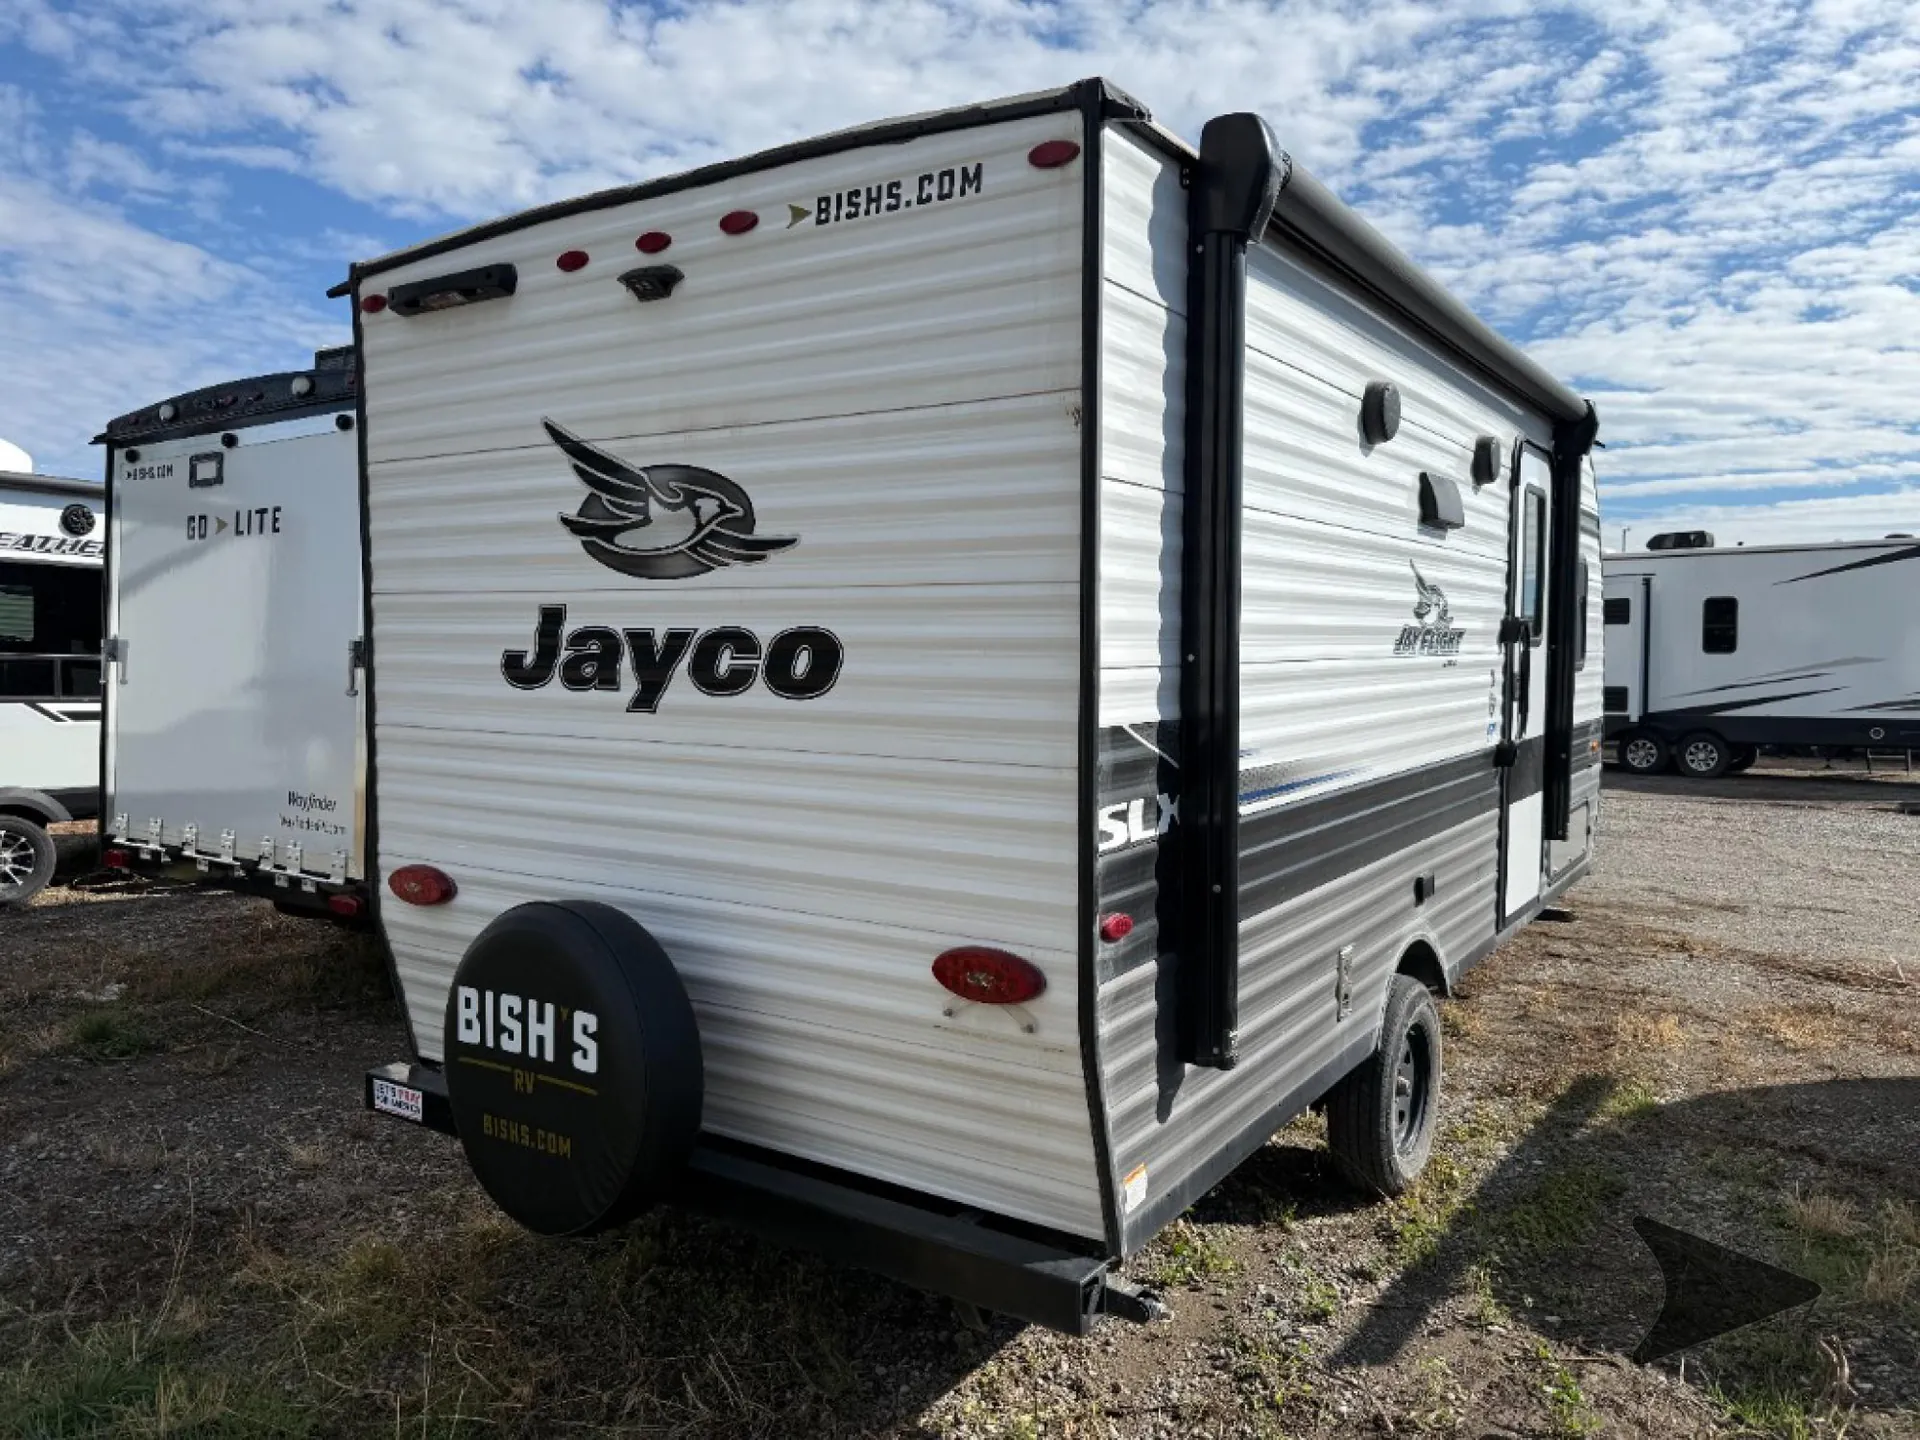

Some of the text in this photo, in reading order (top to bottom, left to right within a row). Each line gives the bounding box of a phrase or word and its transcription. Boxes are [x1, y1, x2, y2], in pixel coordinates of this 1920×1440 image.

[814, 162, 984, 227] BISHS.COM
[187, 505, 283, 541] GO LITE
[0, 531, 104, 559] EATHE
[500, 603, 845, 714] Jayco
[513, 1067, 537, 1095] RV
[482, 1112, 572, 1160] BISHS.COM
